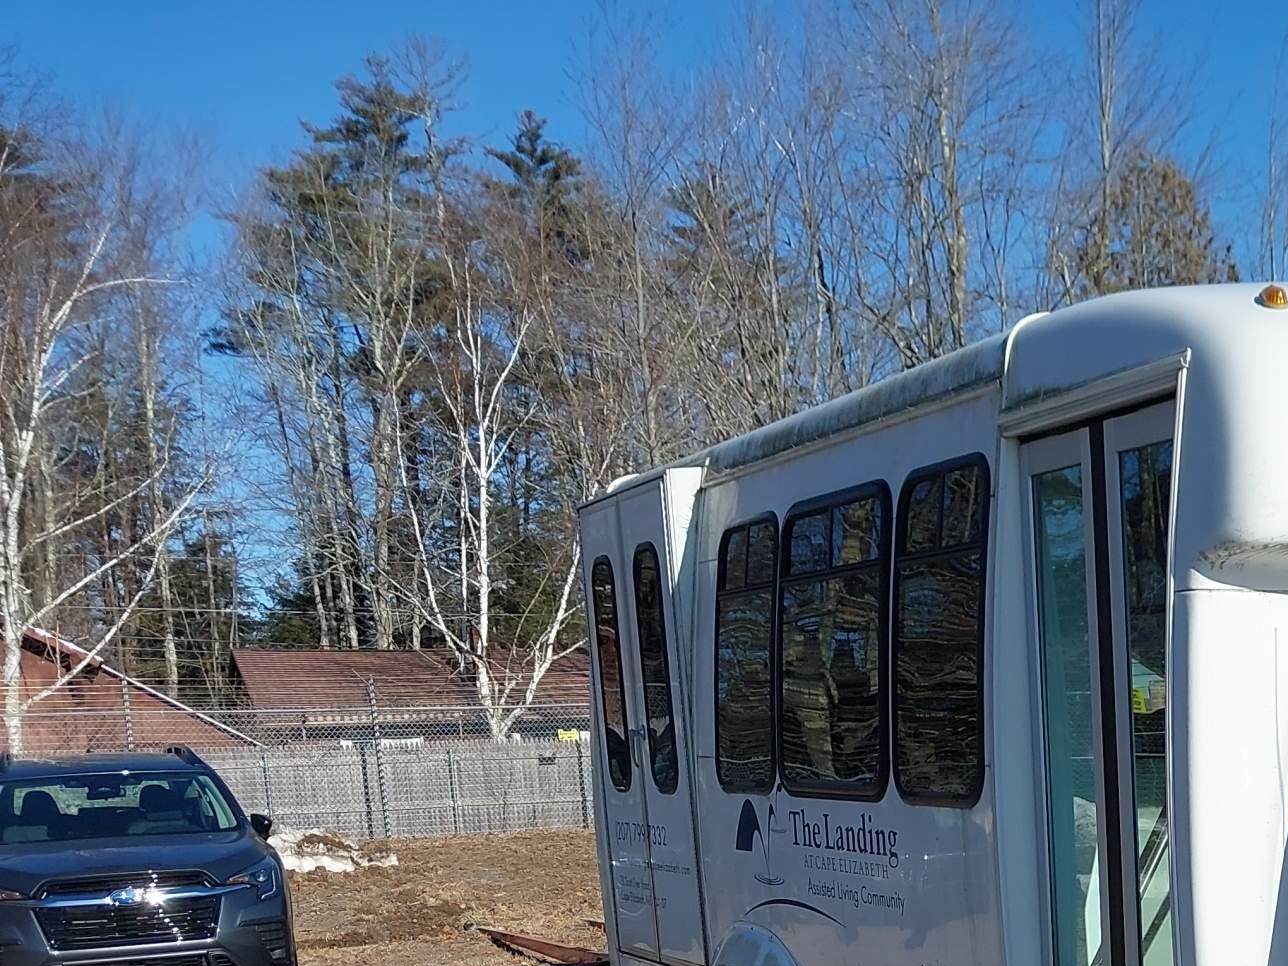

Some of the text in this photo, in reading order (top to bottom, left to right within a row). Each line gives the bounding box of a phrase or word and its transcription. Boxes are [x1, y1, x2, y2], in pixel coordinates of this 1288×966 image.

[632, 823, 668, 847] 7997332
[788, 808, 899, 869] The Landing
[803, 854, 890, 880] AT CAPE ELIZABETH
[807, 878, 905, 917] Assisted Living Community
